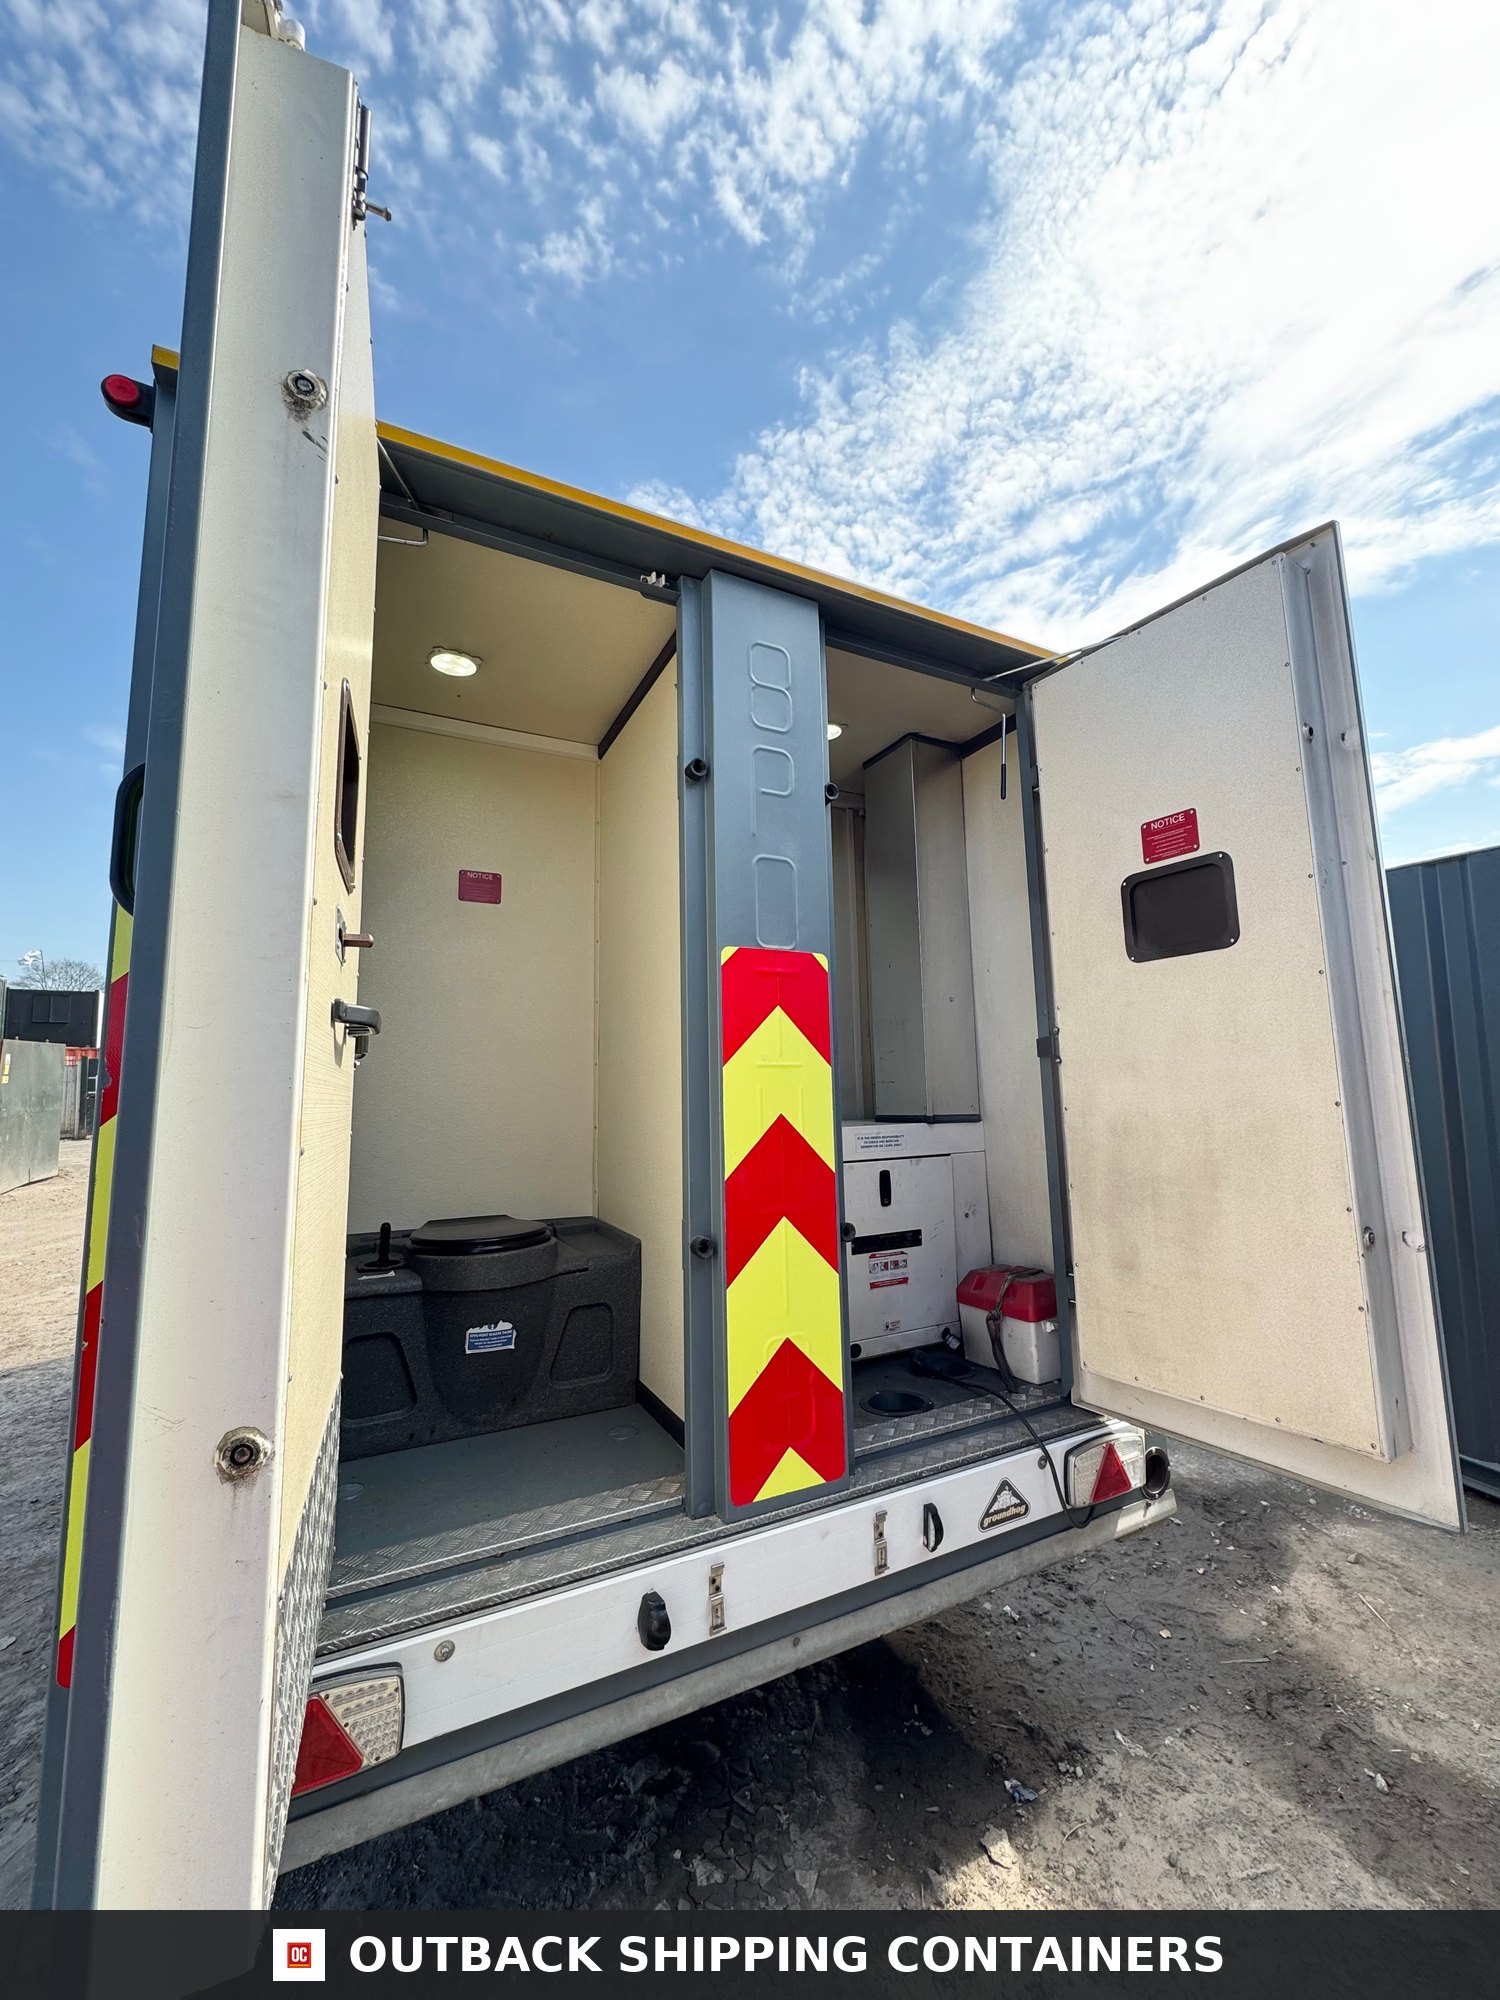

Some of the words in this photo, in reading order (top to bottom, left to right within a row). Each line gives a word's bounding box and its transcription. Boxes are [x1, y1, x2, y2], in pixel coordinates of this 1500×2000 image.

[1151, 813, 1186, 831] NOTICE
[467, 872, 494, 880] NOTICE
[983, 1504, 1026, 1527] groundhog
